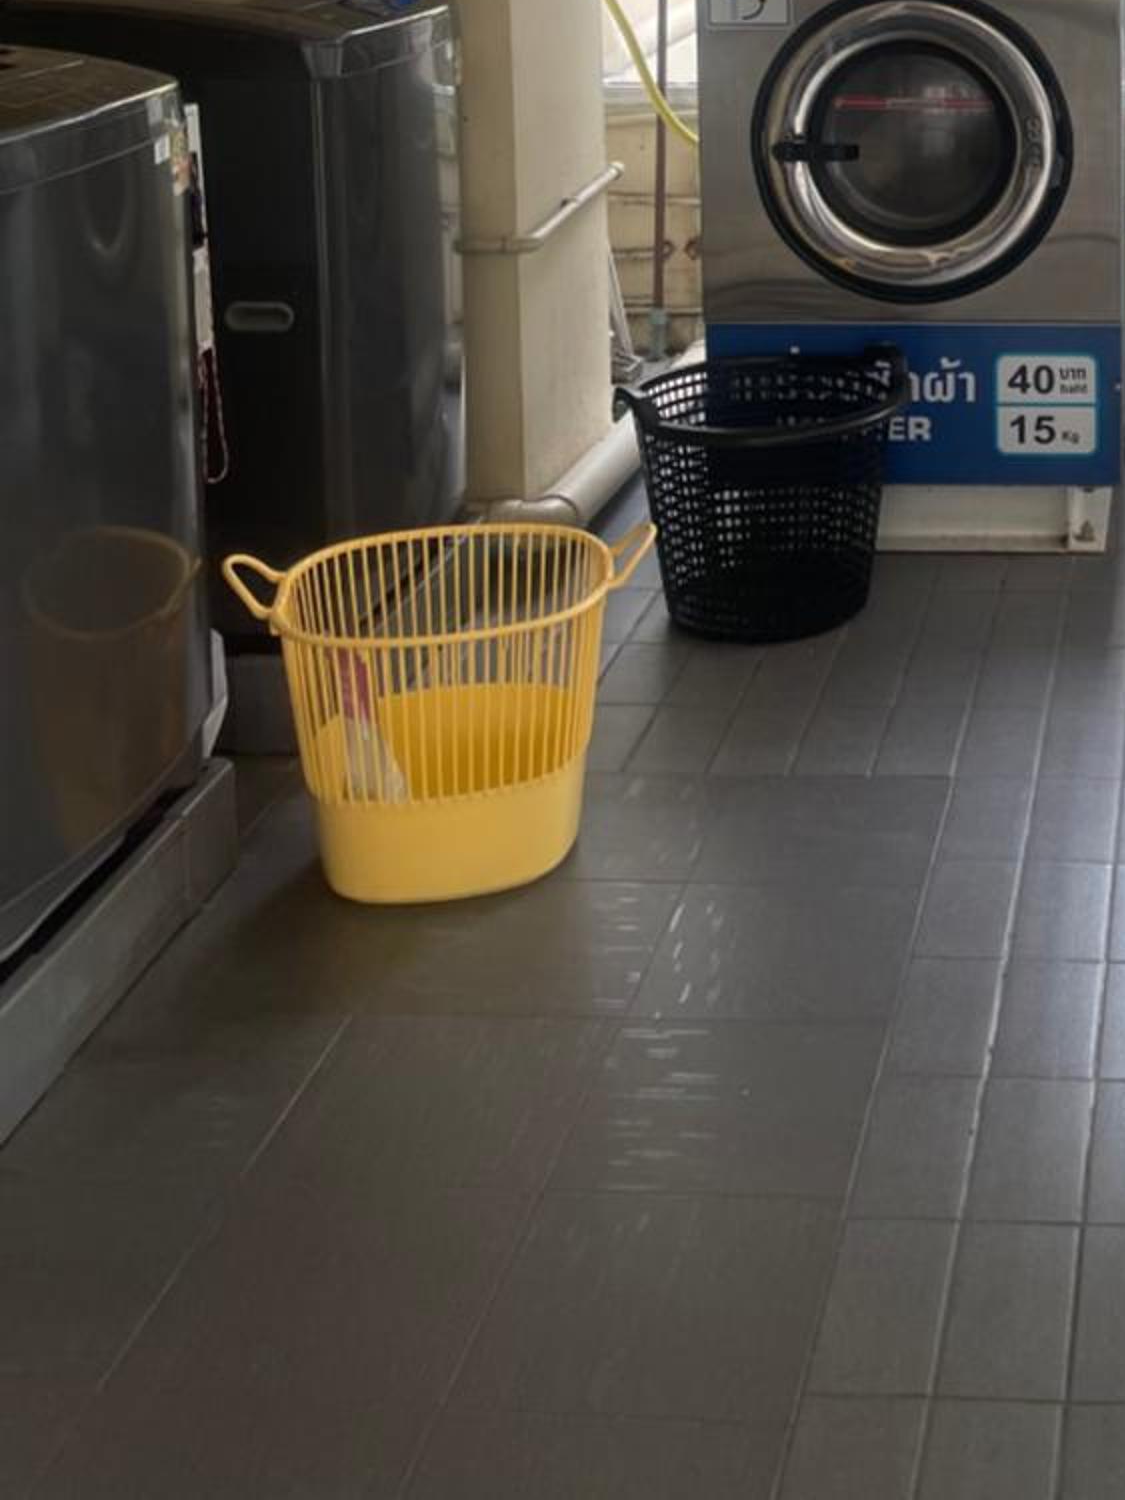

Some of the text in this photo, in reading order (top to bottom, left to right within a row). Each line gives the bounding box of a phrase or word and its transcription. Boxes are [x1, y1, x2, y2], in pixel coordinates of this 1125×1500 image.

[1007, 364, 1088, 395] 40 บาท
[1010, 414, 1056, 445] 15
